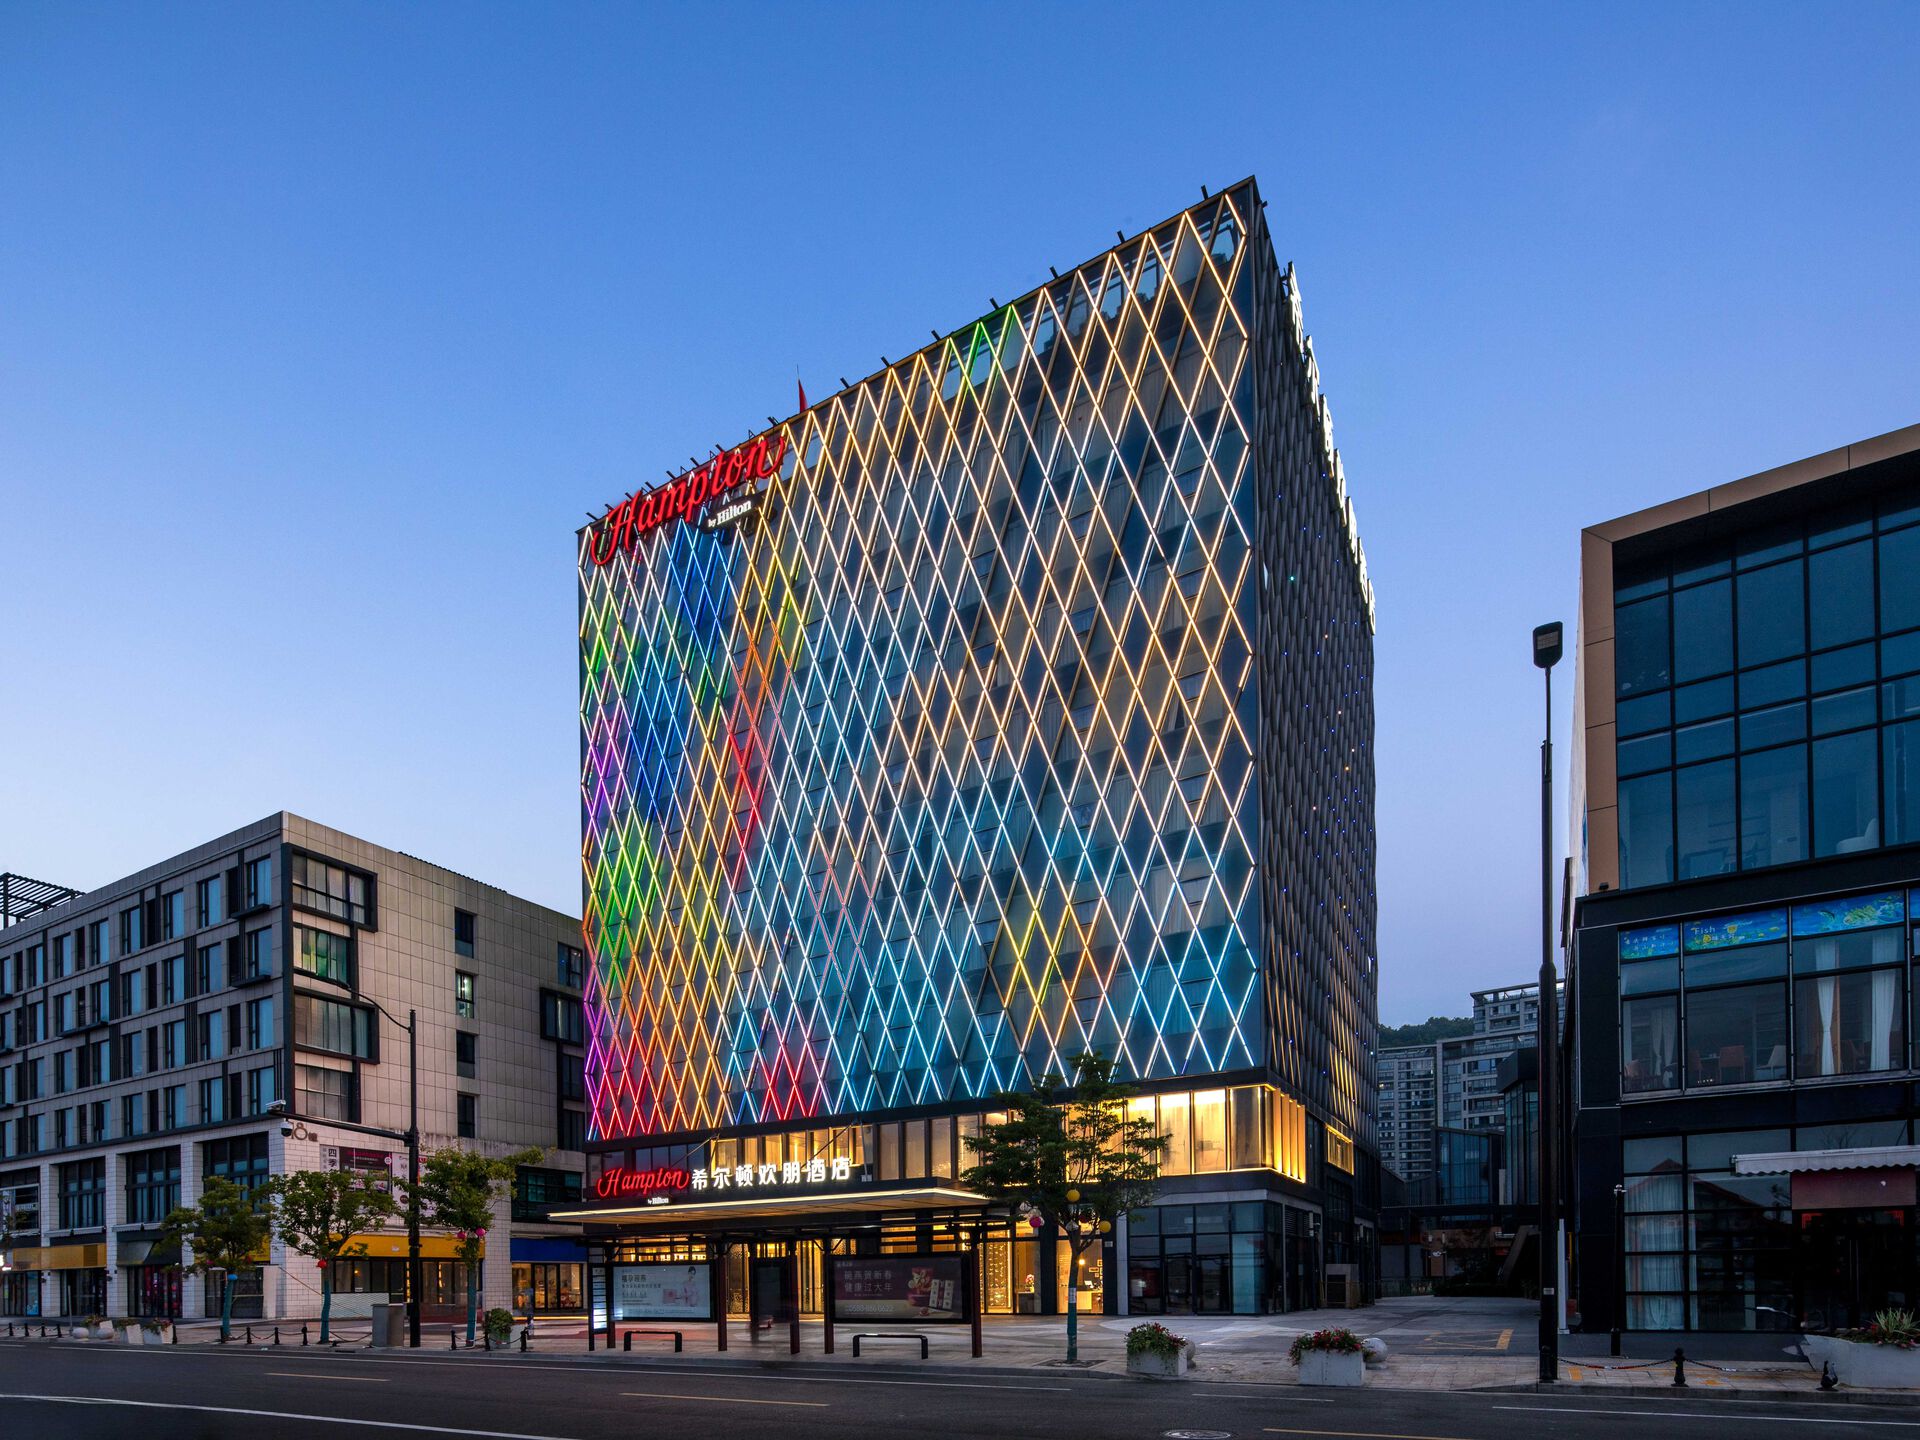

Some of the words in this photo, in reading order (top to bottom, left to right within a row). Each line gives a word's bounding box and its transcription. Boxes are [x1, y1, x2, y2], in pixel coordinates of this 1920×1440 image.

[591, 435, 786, 566] Hampton
[708, 518, 716, 528] by
[716, 499, 752, 526] Hilton
[597, 1167, 690, 1197] Hampton
[691, 1157, 852, 1191] 希尔顿欢朋酒店
[652, 1196, 669, 1204] Hilton
